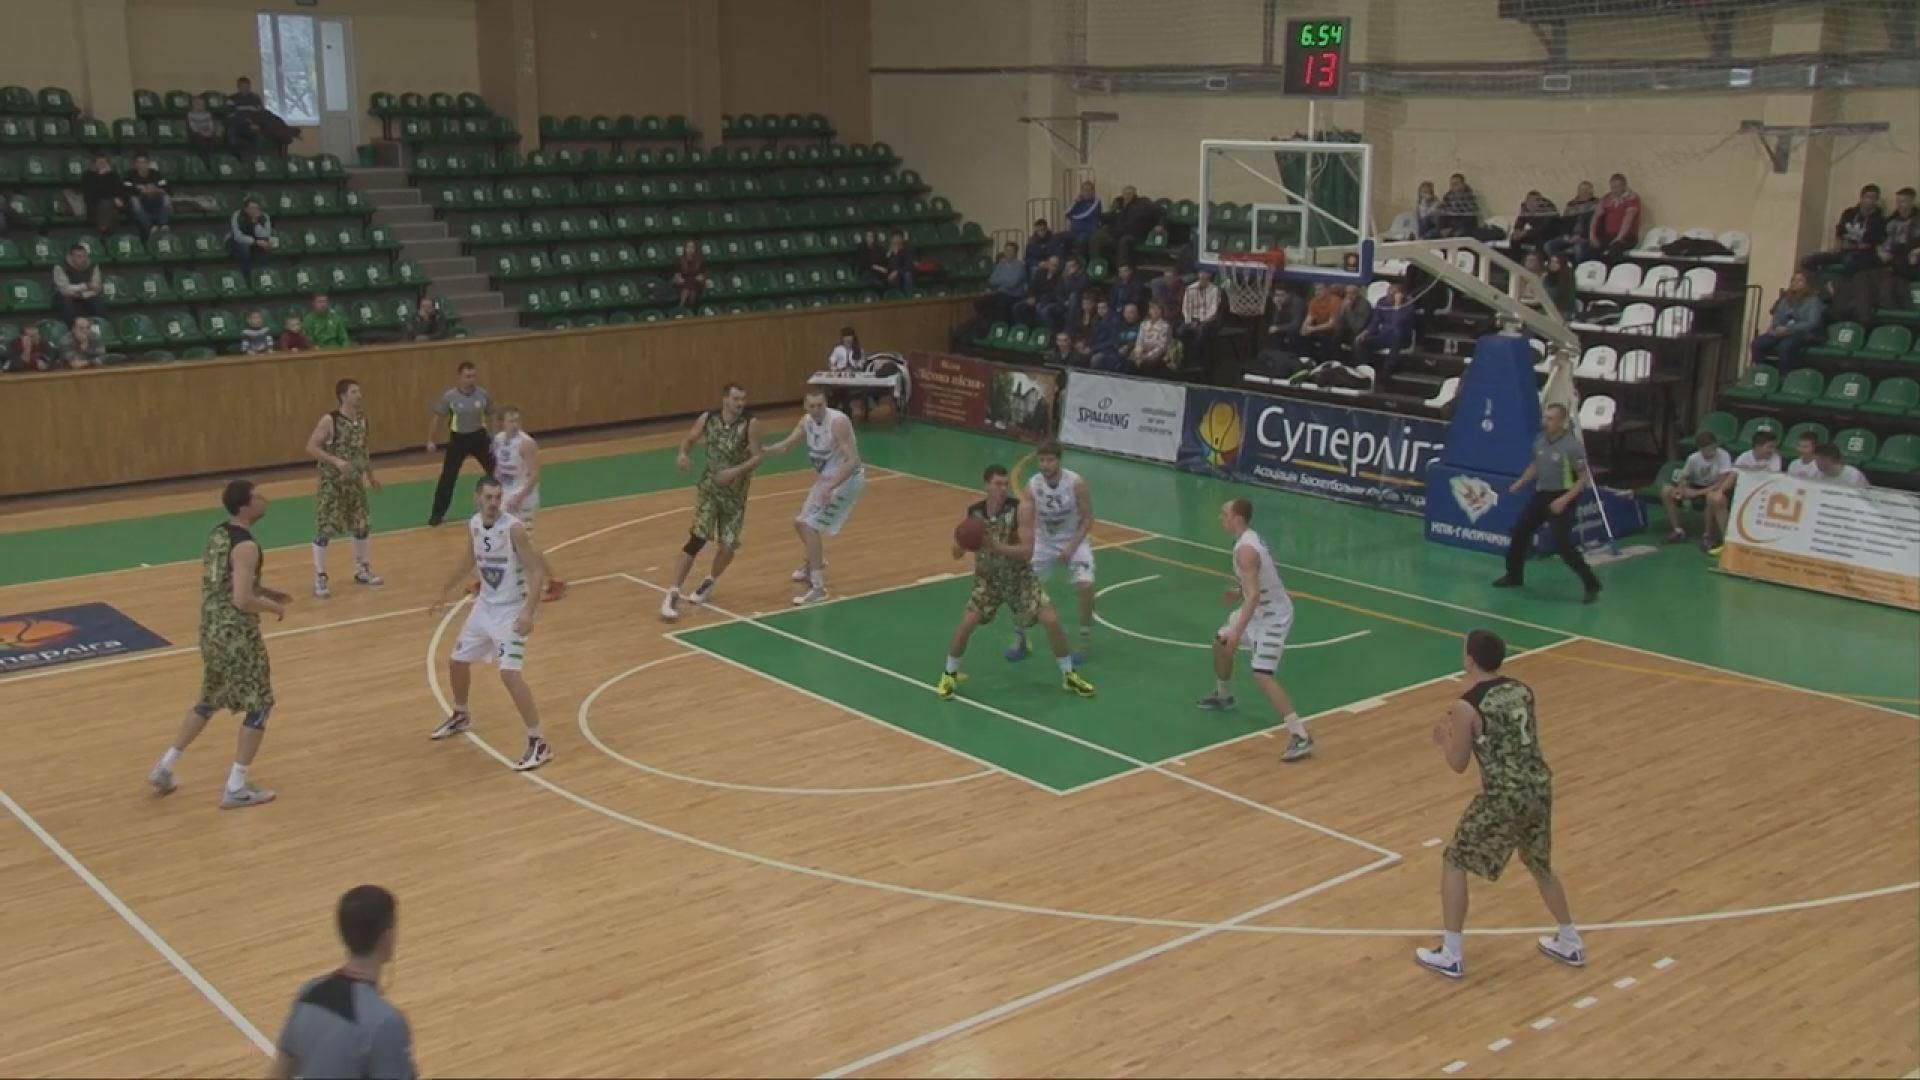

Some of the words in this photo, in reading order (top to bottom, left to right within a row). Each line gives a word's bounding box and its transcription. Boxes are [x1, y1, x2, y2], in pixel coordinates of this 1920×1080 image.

[1301, 24, 1342, 46] 6.54
[1303, 53, 1338, 88] 13
[1077, 405, 1131, 430] SPALDING
[1511, 707, 1531, 745] 7
